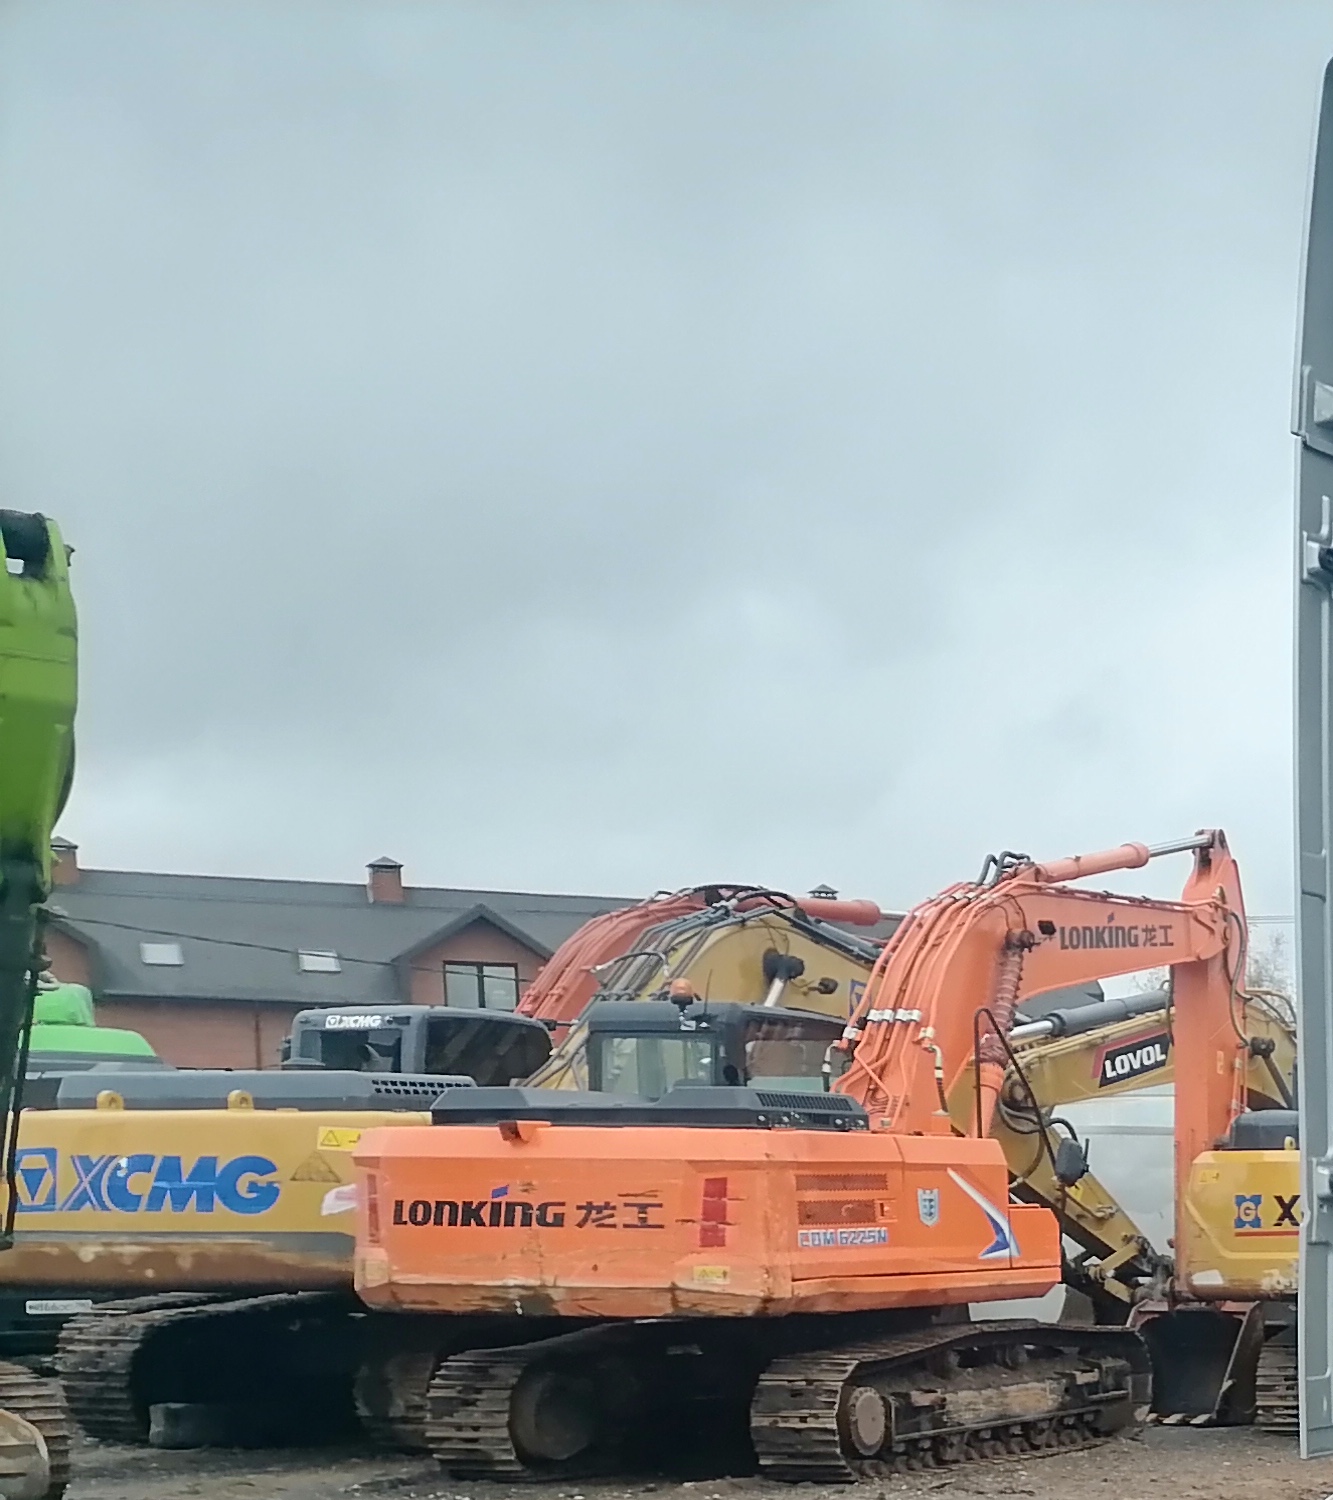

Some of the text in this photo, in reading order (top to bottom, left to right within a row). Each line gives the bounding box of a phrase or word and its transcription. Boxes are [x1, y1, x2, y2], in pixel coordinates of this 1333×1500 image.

[1141, 924, 1174, 947] 龙工
[1104, 1043, 1167, 1078] LOVOL
[62, 1154, 281, 1215] XCMG
[575, 1202, 665, 1229] 龙工
[798, 1229, 835, 1247] CDM
